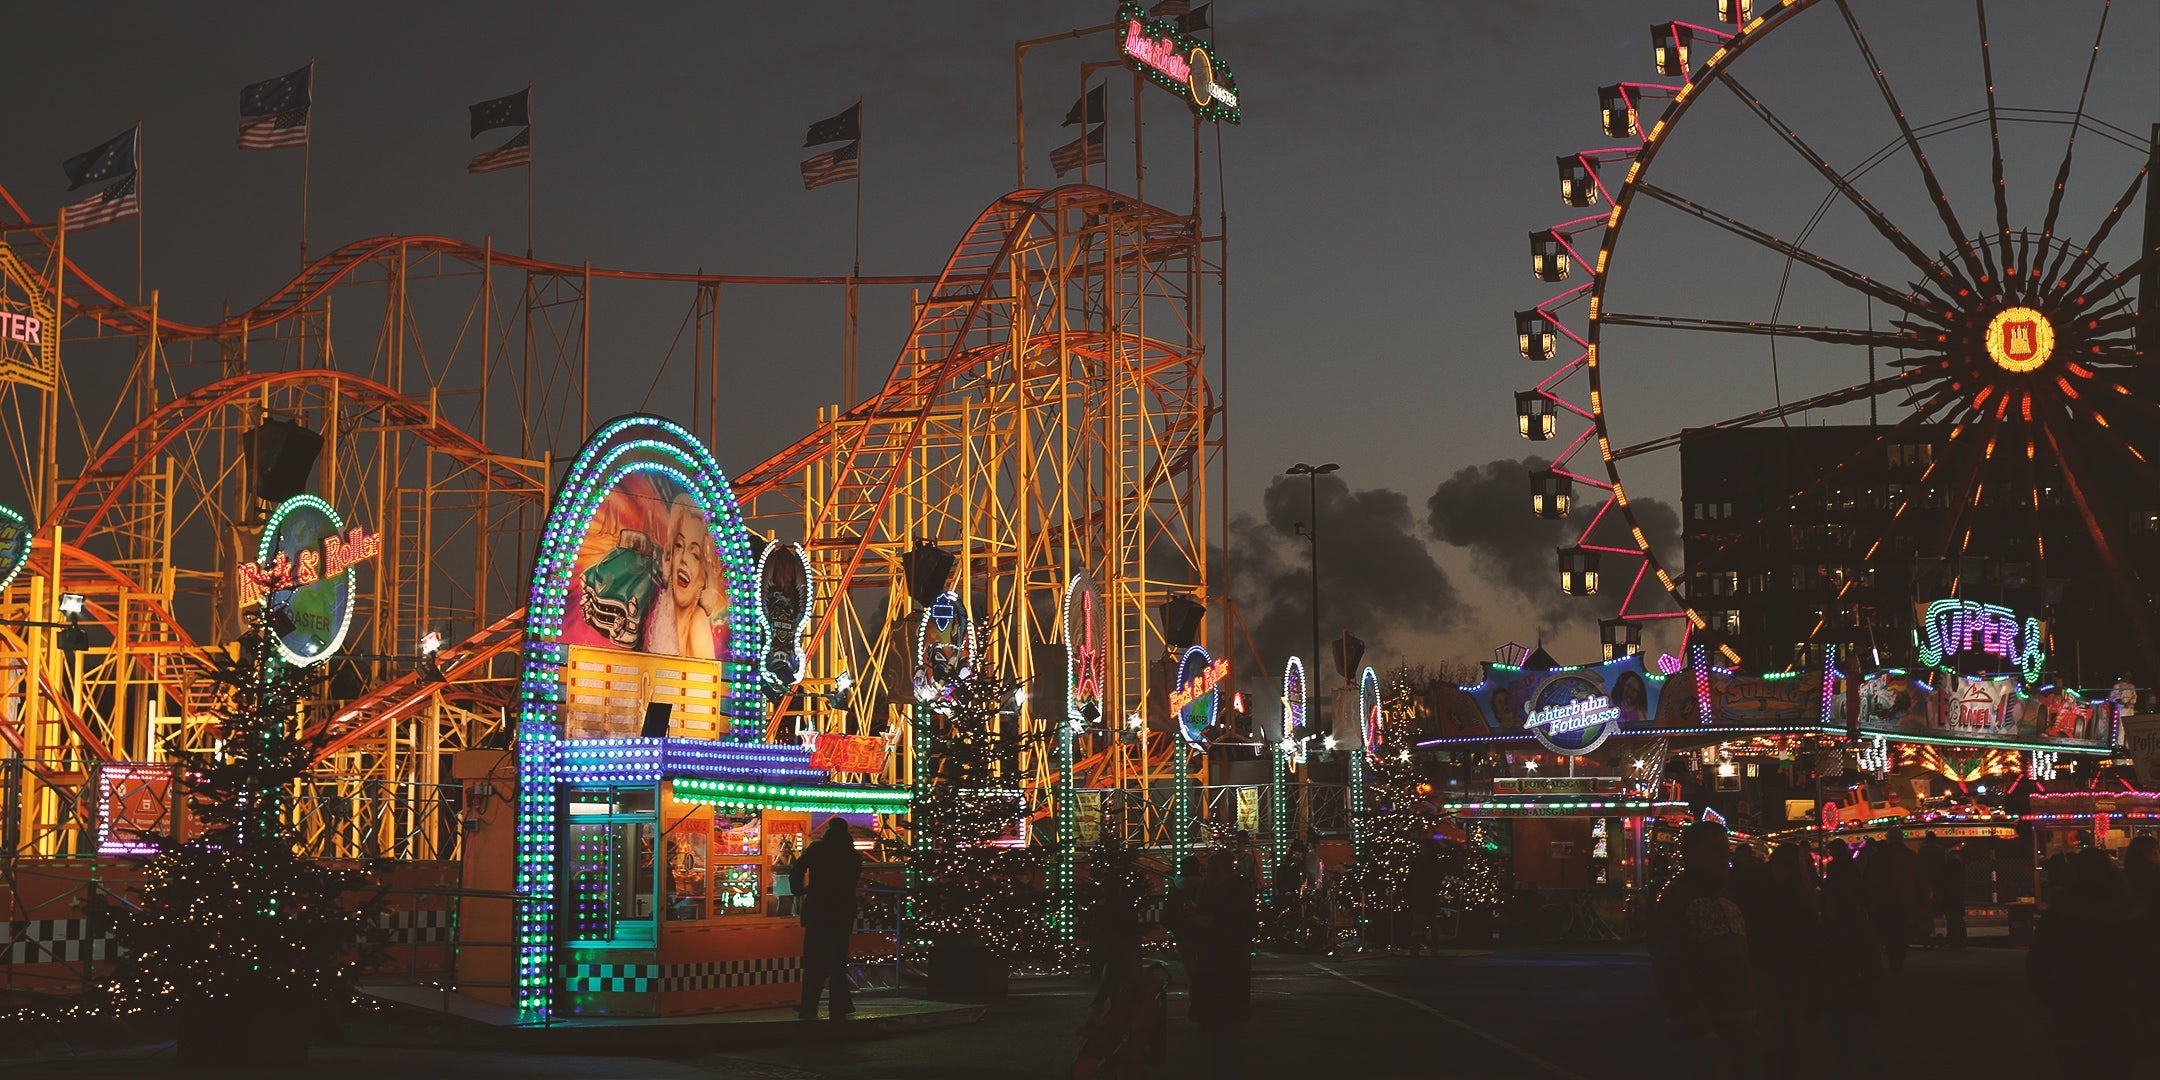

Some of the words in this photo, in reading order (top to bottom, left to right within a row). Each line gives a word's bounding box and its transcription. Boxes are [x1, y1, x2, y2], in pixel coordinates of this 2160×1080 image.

[1209, 81, 1238, 107] COASTER
[297, 550, 320, 585] &
[324, 526, 381, 577] Roller
[286, 609, 331, 632] OASTER
[1919, 598, 2022, 667] SUPER
[1185, 714, 1209, 725] COASTER
[1524, 694, 1609, 730] Achterbahn
[1548, 707, 1621, 736] Fotokasse
[814, 736, 884, 770] KASSE
